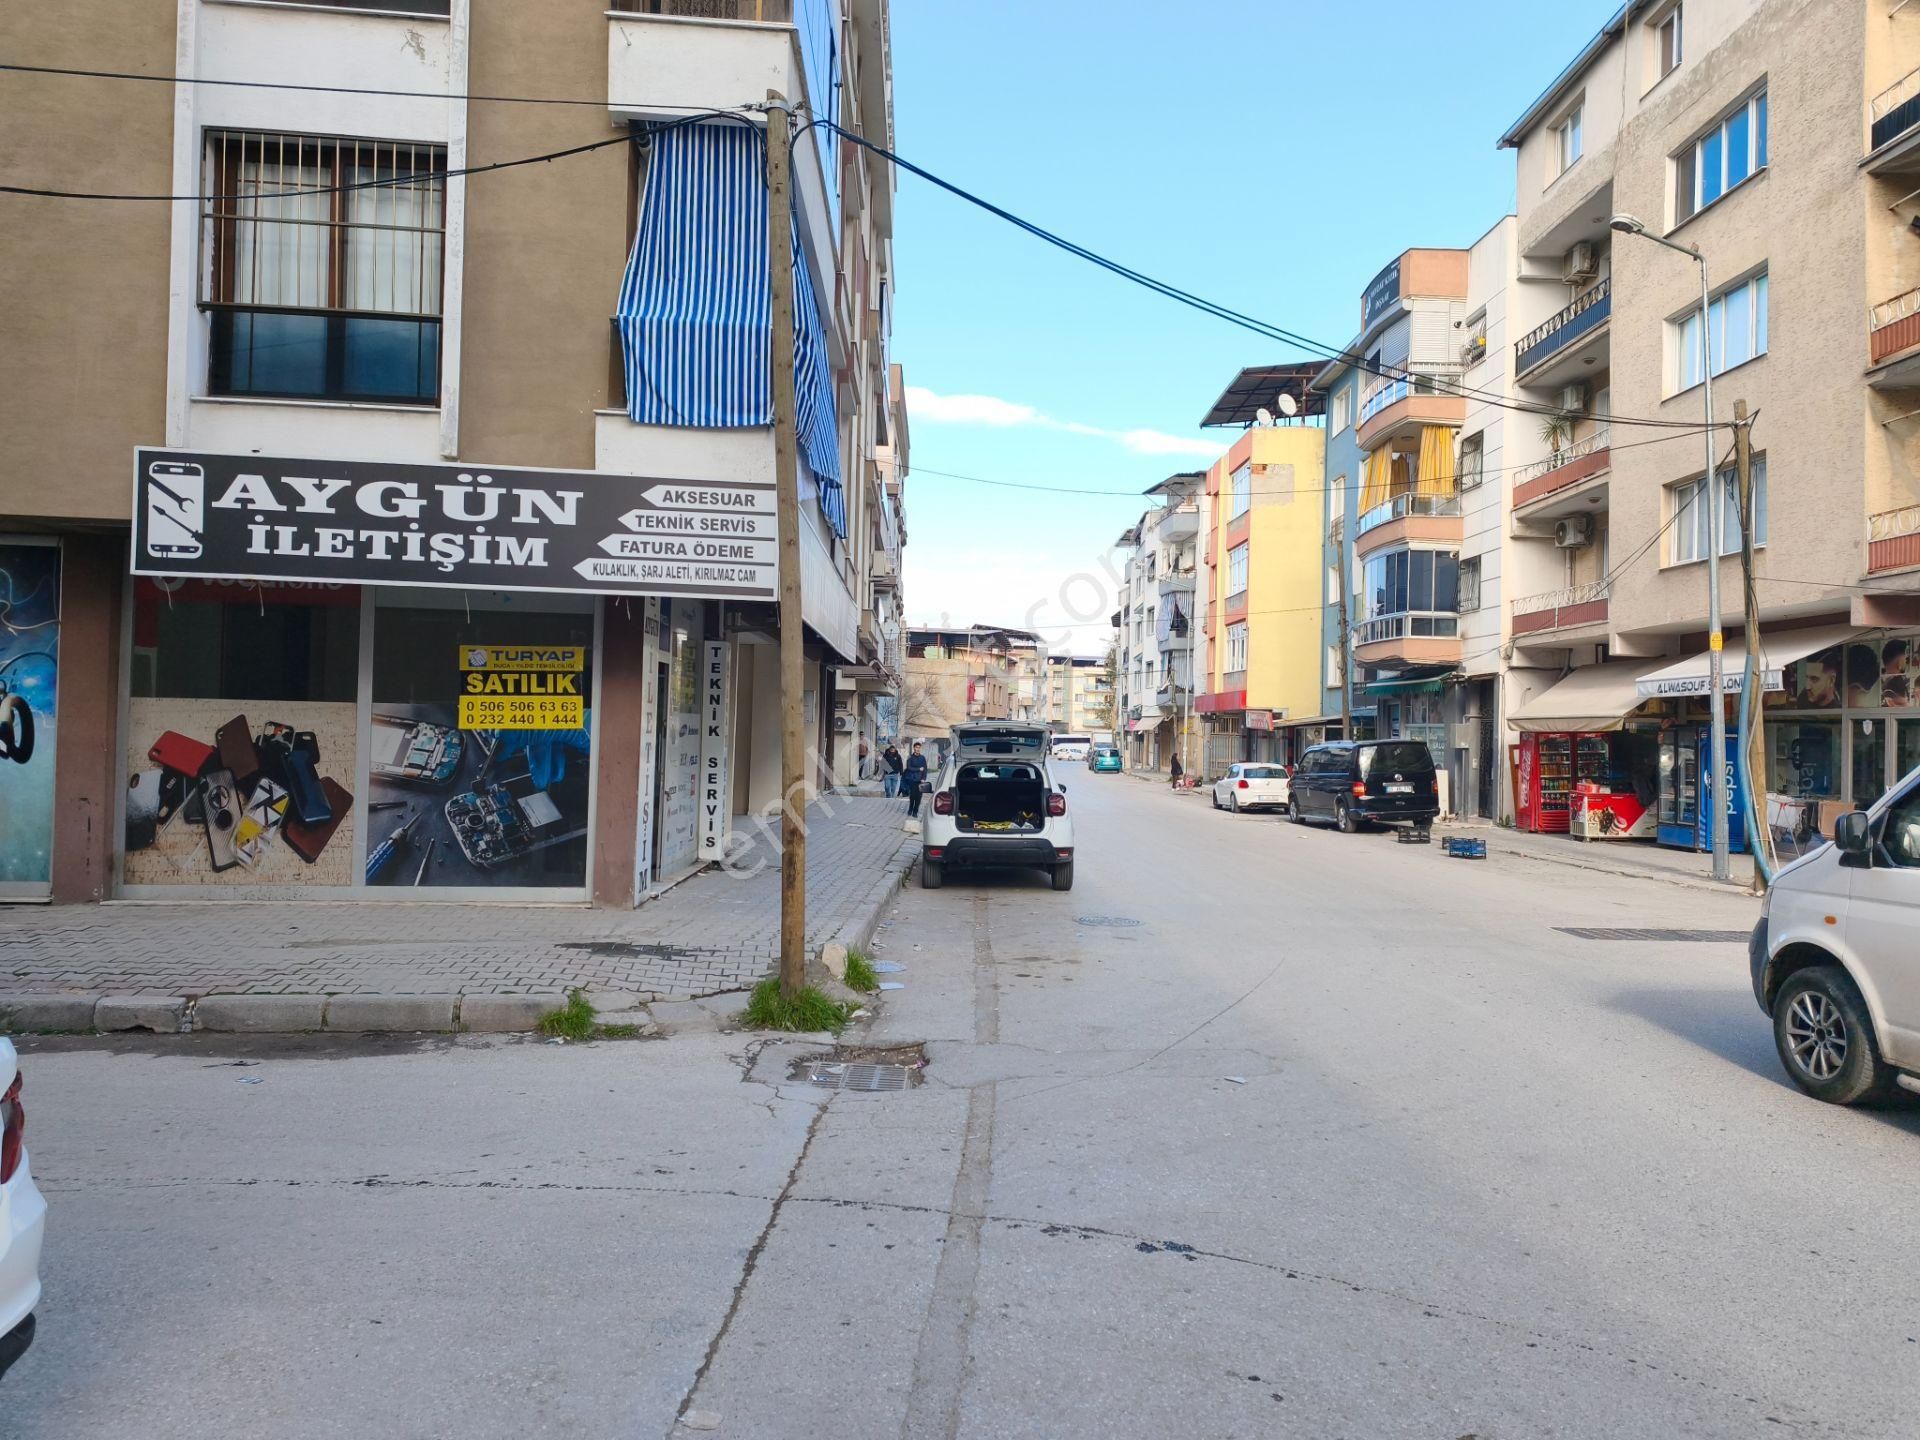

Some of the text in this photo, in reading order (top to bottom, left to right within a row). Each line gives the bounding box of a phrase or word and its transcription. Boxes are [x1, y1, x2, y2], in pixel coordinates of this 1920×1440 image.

[211, 473, 584, 526] AYGÜN
[662, 490, 756, 507] AKSESUAR
[635, 514, 756, 533] TEKNİK SERVİS
[246, 515, 549, 572] İLETİŞİM
[620, 540, 754, 559] FATURA ÖDEME
[592, 562, 756, 582] KULAKLIK, ŞARJ ALETİ, KIRILMAZ CAM
[491, 650, 575, 661] TURYAP
[466, 672, 577, 694] SATILIK
[466, 701, 577, 712] 0 506 506 63 63
[466, 714, 578, 724] 0 232 440 1 444
